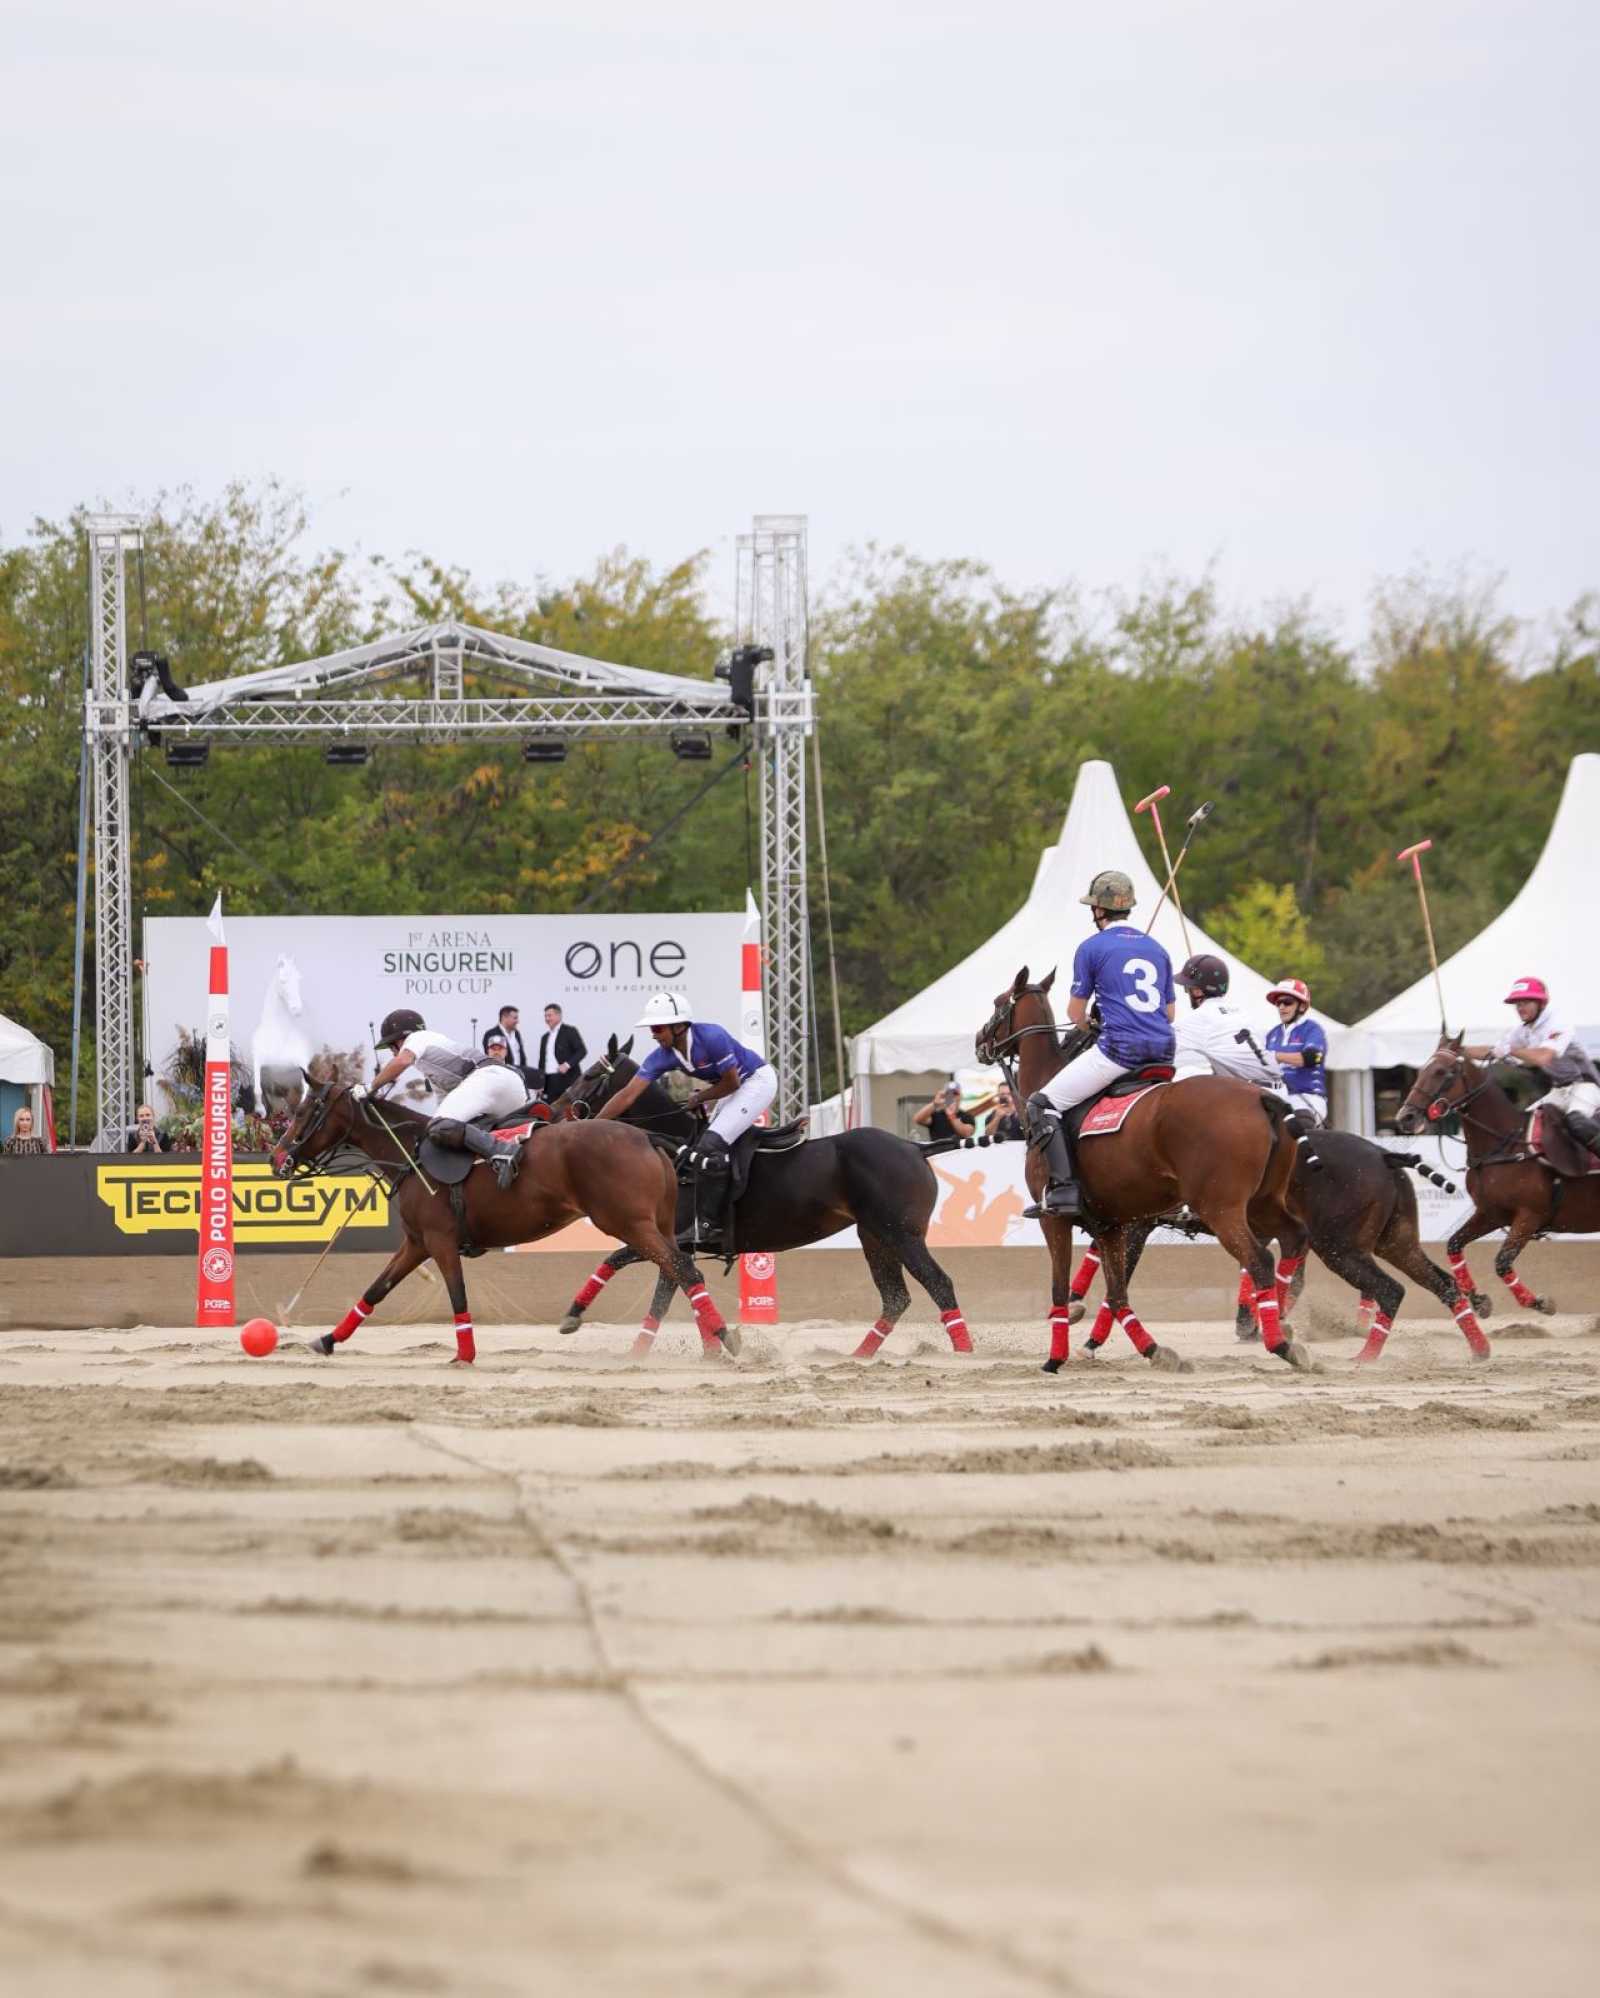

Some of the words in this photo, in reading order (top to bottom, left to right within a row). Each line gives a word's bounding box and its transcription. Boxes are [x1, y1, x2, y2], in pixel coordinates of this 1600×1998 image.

[428, 931, 493, 948] ARENA
[383, 951, 513, 974] SINGURENI
[565, 940, 687, 979] one
[404, 977, 453, 995] POLO
[457, 977, 493, 994] CUP
[1122, 958, 1161, 1014] 3
[210, 1071, 228, 1180] SINGURENI
[209, 1186, 227, 1242] POLO
